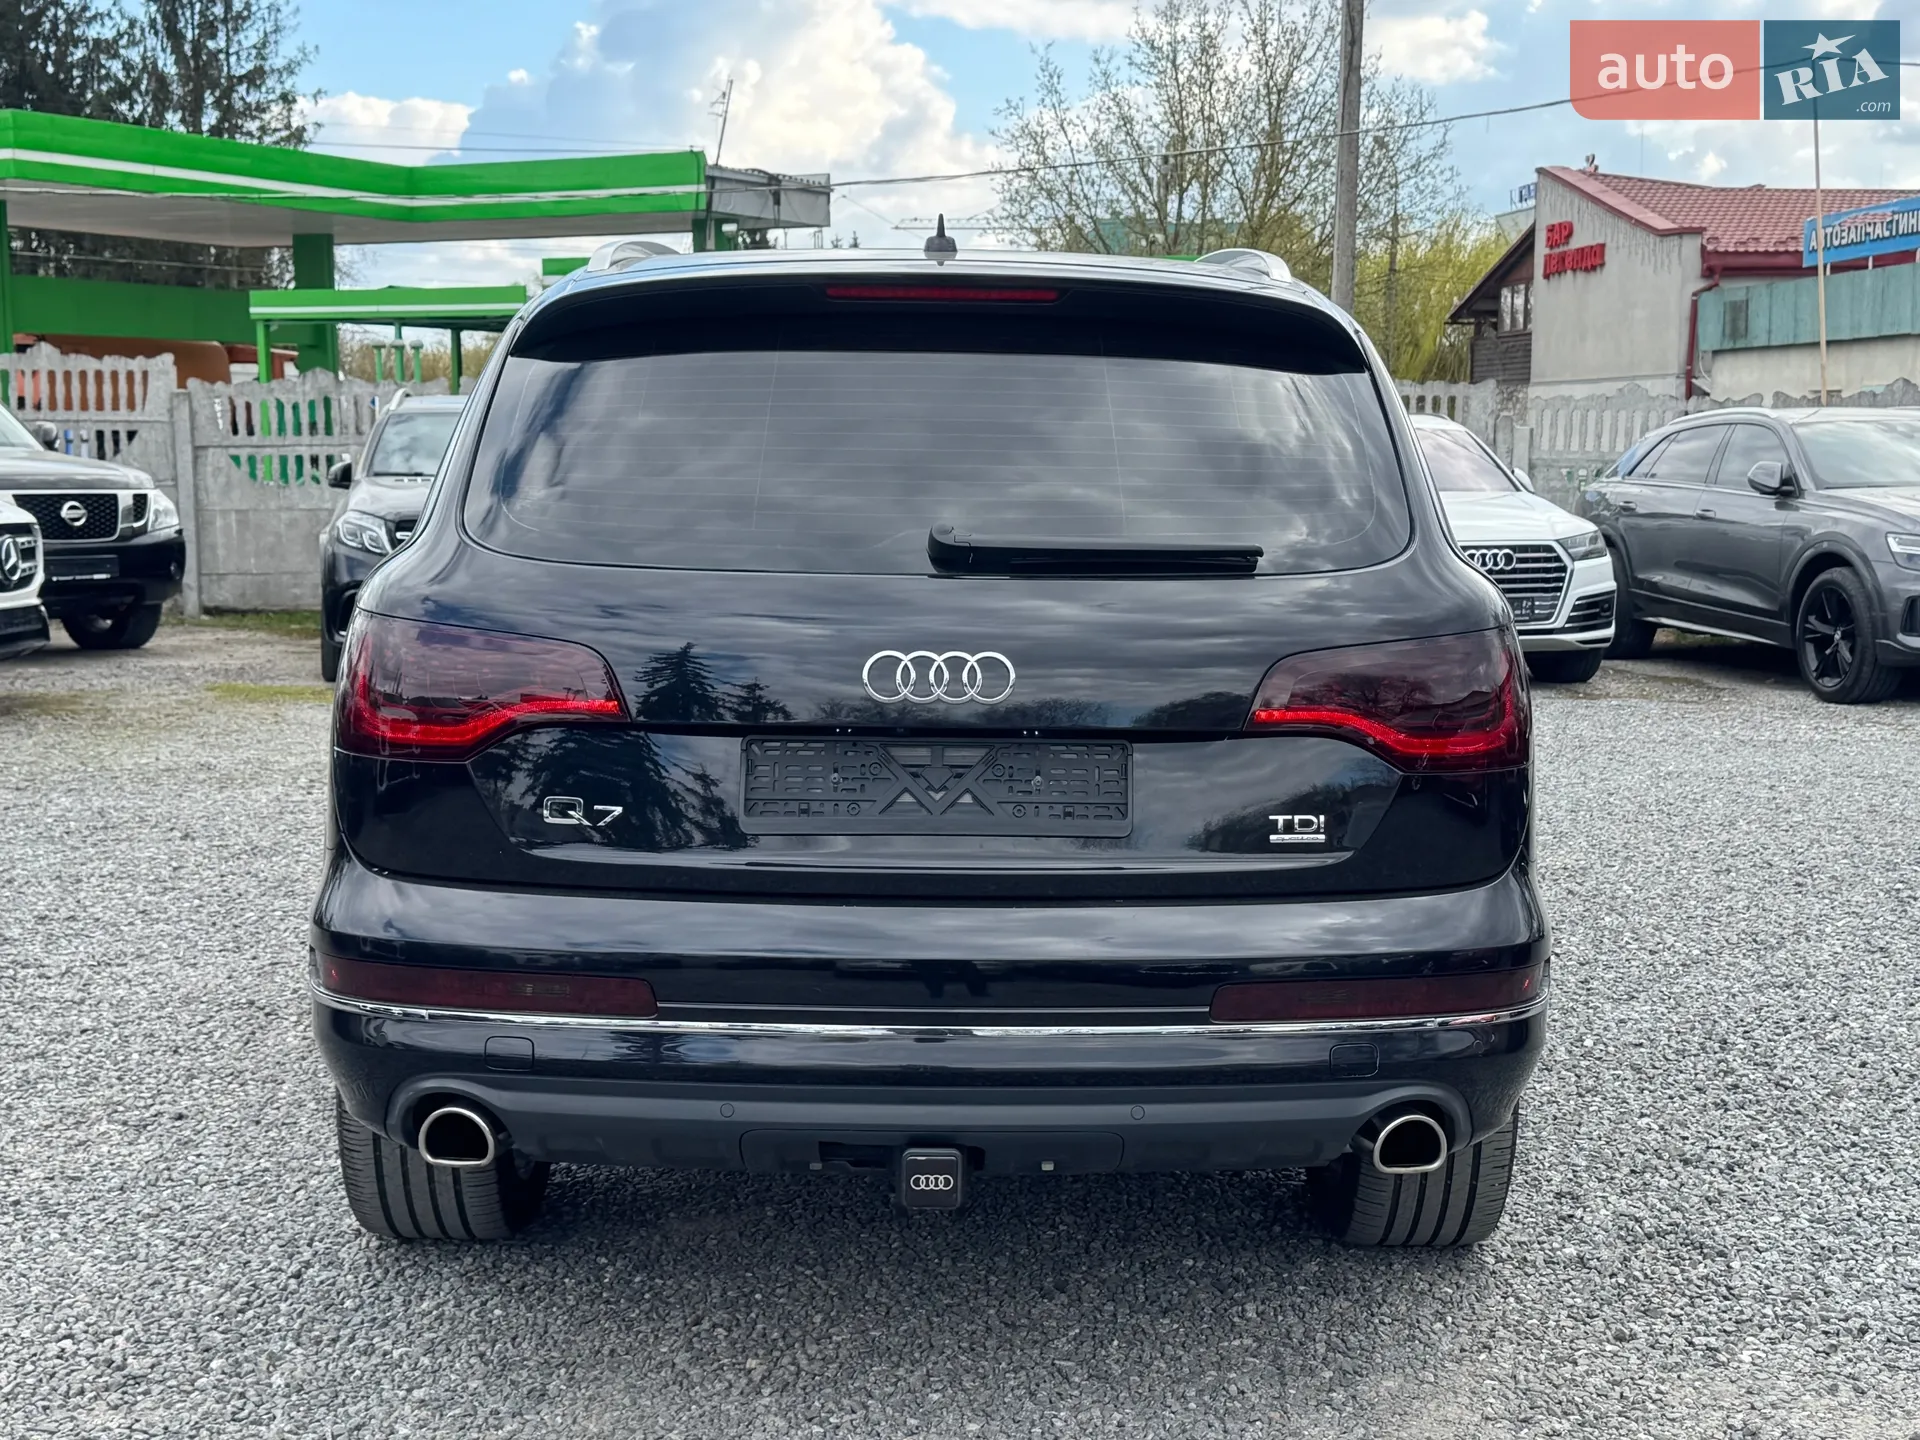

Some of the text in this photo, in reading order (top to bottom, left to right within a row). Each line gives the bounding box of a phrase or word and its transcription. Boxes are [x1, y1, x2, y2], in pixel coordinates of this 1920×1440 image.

[1545, 221, 1573, 249] БАР
[1809, 210, 1920, 251] АТОЗАПЧАСТИН
[543, 796, 623, 826] Q7
[1268, 815, 1325, 832] TDI
